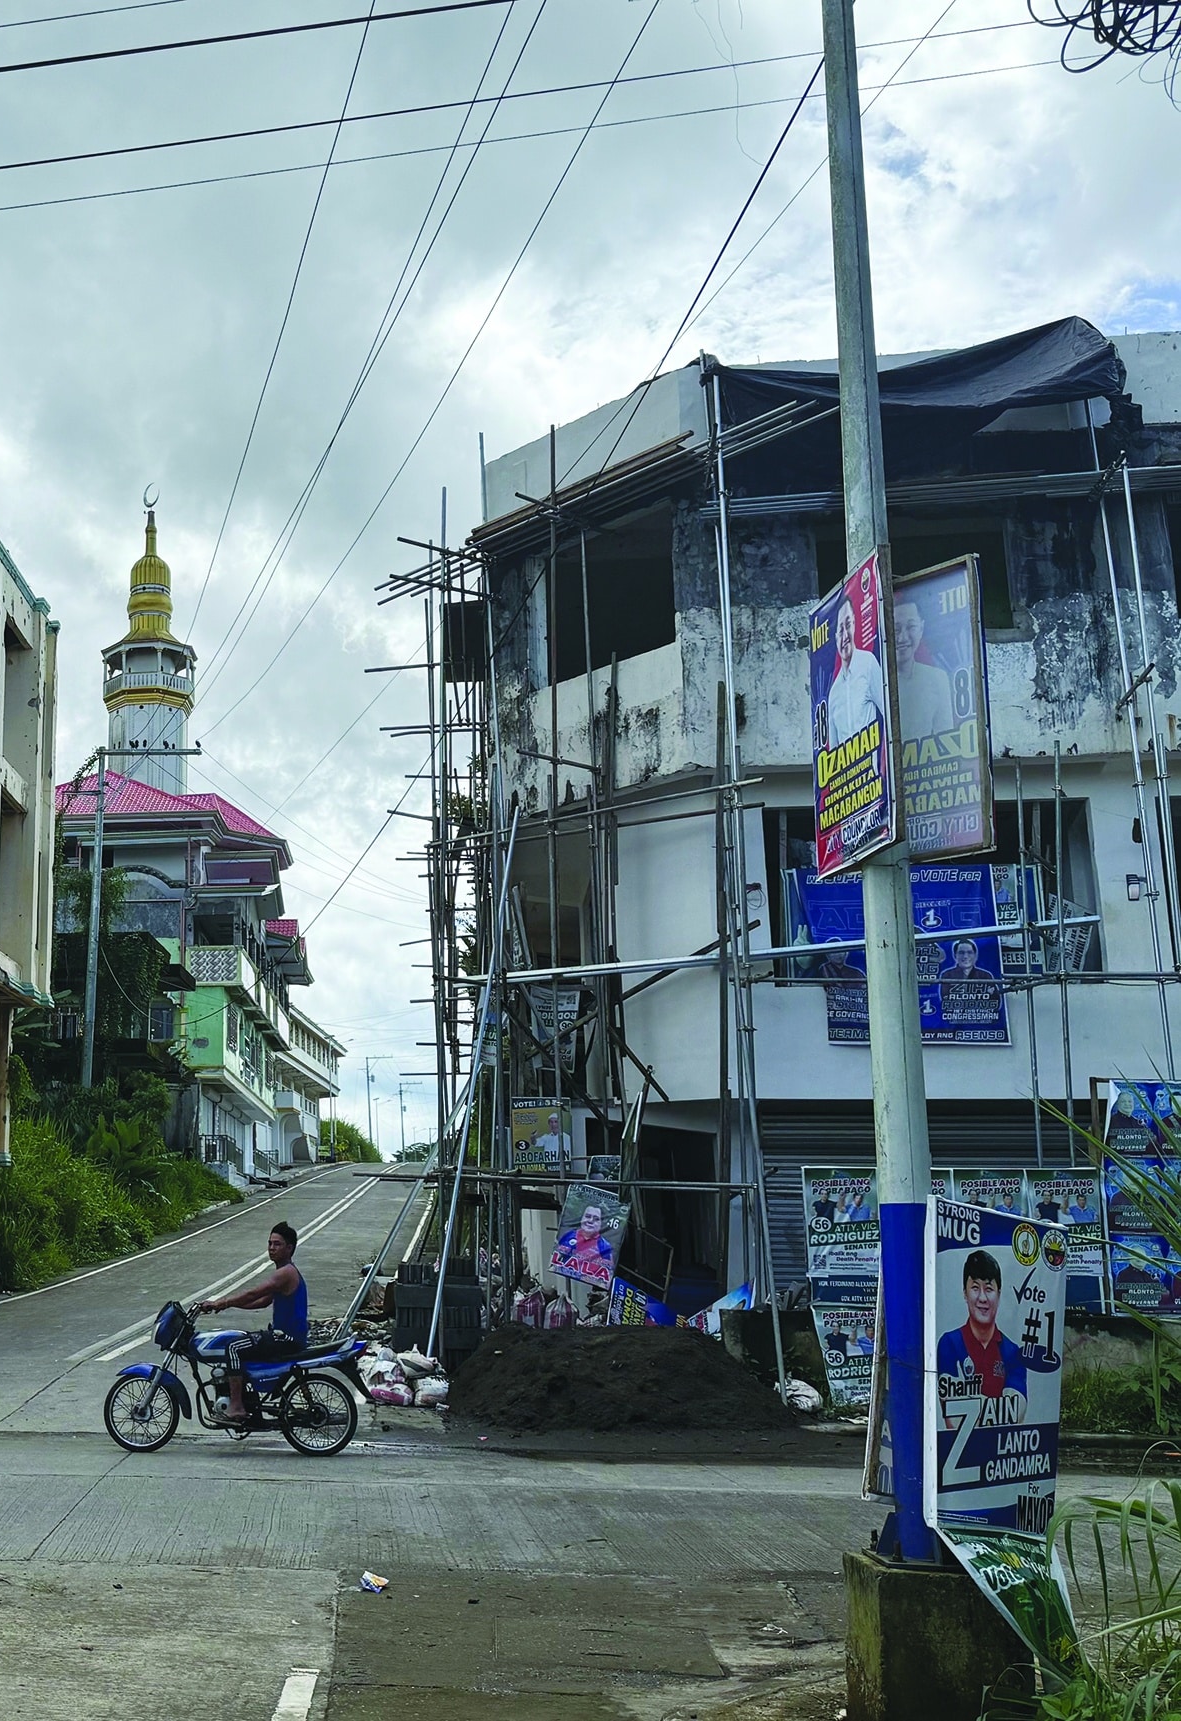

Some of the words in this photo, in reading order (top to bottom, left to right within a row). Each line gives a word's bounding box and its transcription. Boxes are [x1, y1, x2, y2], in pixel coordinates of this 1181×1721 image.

[811, 617, 829, 653] VOTE
[825, 770, 875, 807] DIMAKUTA
[820, 777, 883, 831] MACABANGON
[920, 869, 959, 882] VOTE
[959, 871, 982, 881] FOR
[925, 908, 938, 926] 1
[923, 999, 932, 1013] 1
[955, 1030, 1005, 1040] ASENSO
[519, 1141, 526, 1149] 3
[515, 1150, 570, 1162] ABOFARHN
[811, 1179, 849, 1188] POSIBLE
[849, 1178, 871, 1186] ANG
[960, 1180, 999, 1188] POSIBLE
[999, 1179, 1020, 1187] ANG
[1034, 1181, 1071, 1189] POSIBLE
[1072, 1180, 1093, 1188] ANG
[937, 1202, 981, 1223] STRONG
[814, 1219, 829, 1230] 56
[835, 1224, 859, 1232] ATTY.
[861, 1222, 877, 1230] VIC
[937, 1215, 981, 1245] MUG
[810, 1231, 879, 1244] RODRIGUEZ
[844, 1243, 878, 1251] SENATOR
[551, 1251, 610, 1281] LALA
[1021, 1307, 1057, 1364] #1
[828, 1353, 842, 1363] 56
[942, 1395, 1019, 1487] ZAIN
[997, 1429, 1040, 1455] LANTO
[985, 1453, 1051, 1482] GANDAMRA
[1028, 1482, 1040, 1495] For
